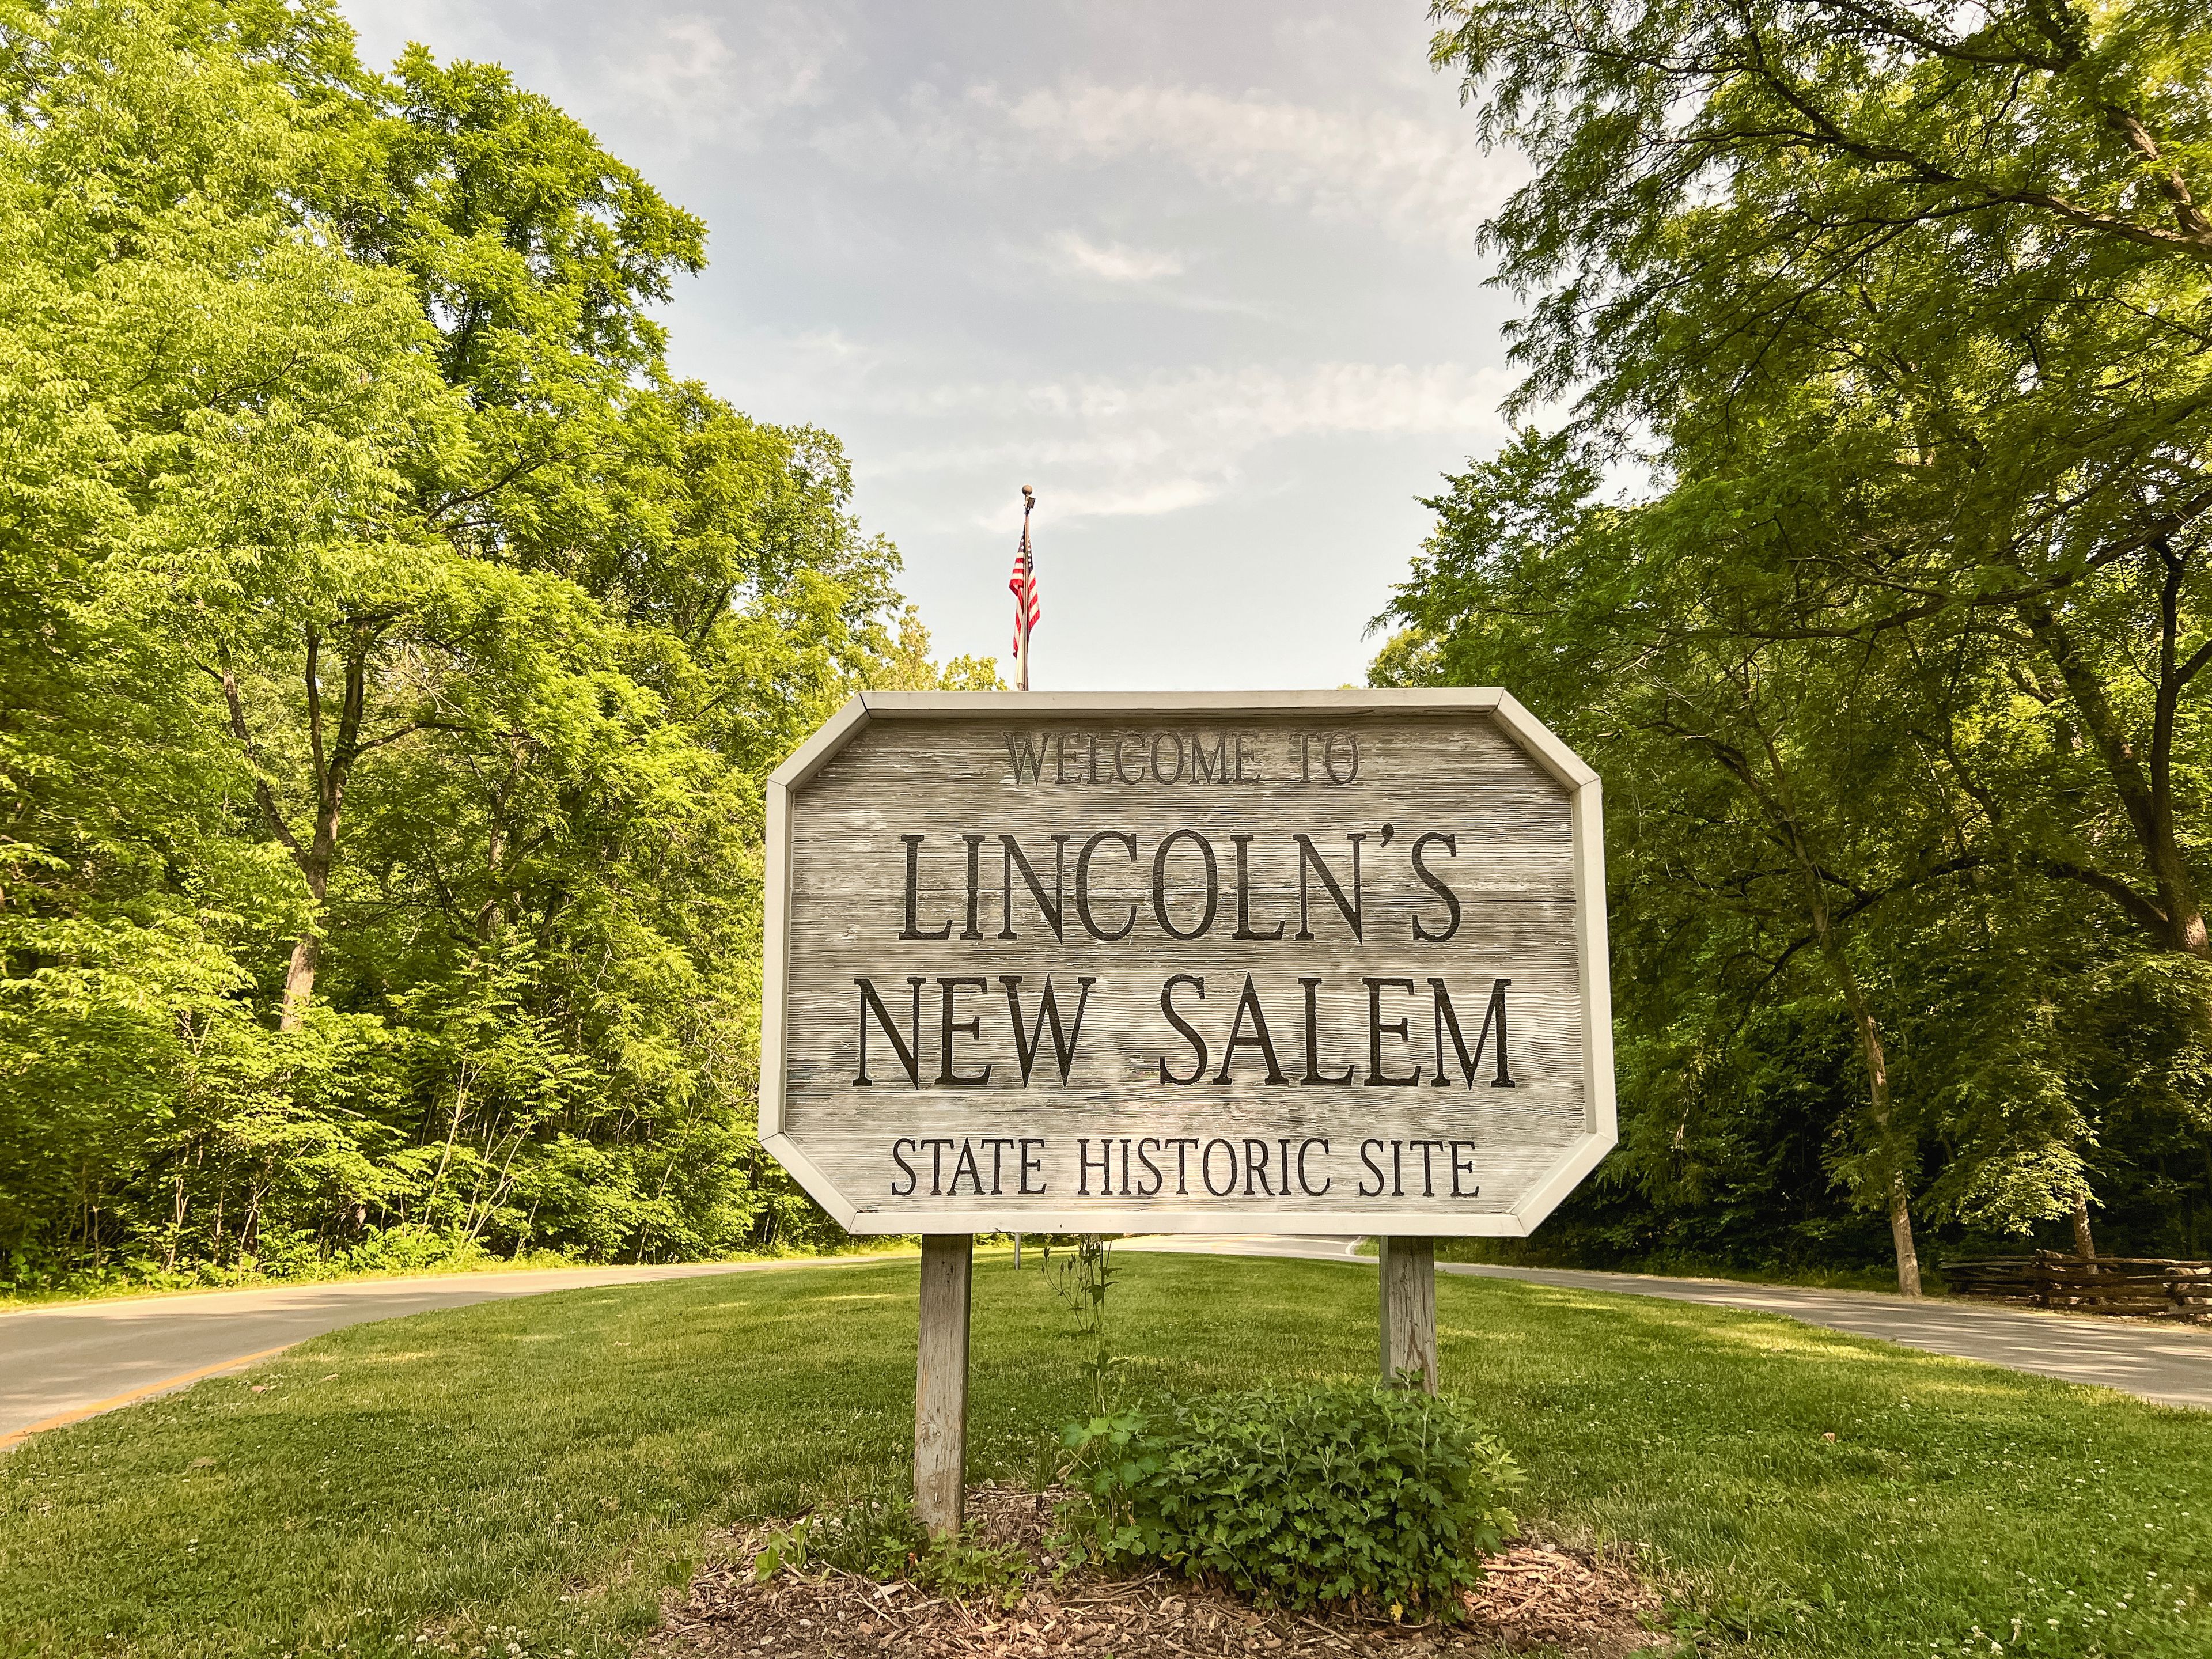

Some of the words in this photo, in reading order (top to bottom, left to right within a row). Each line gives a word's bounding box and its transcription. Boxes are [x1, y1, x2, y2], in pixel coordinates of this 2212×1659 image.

[1003, 731, 1261, 786] WELCOME
[1290, 730, 1359, 785] TO
[899, 823, 1460, 944] LINCOLN'S
[853, 974, 1096, 1090] NEW
[1160, 973, 1515, 1090] SALEM
[891, 1137, 1047, 1196] STATE
[1078, 1137, 1330, 1196] HISTORIC
[1358, 1139, 1479, 1198] SITE
